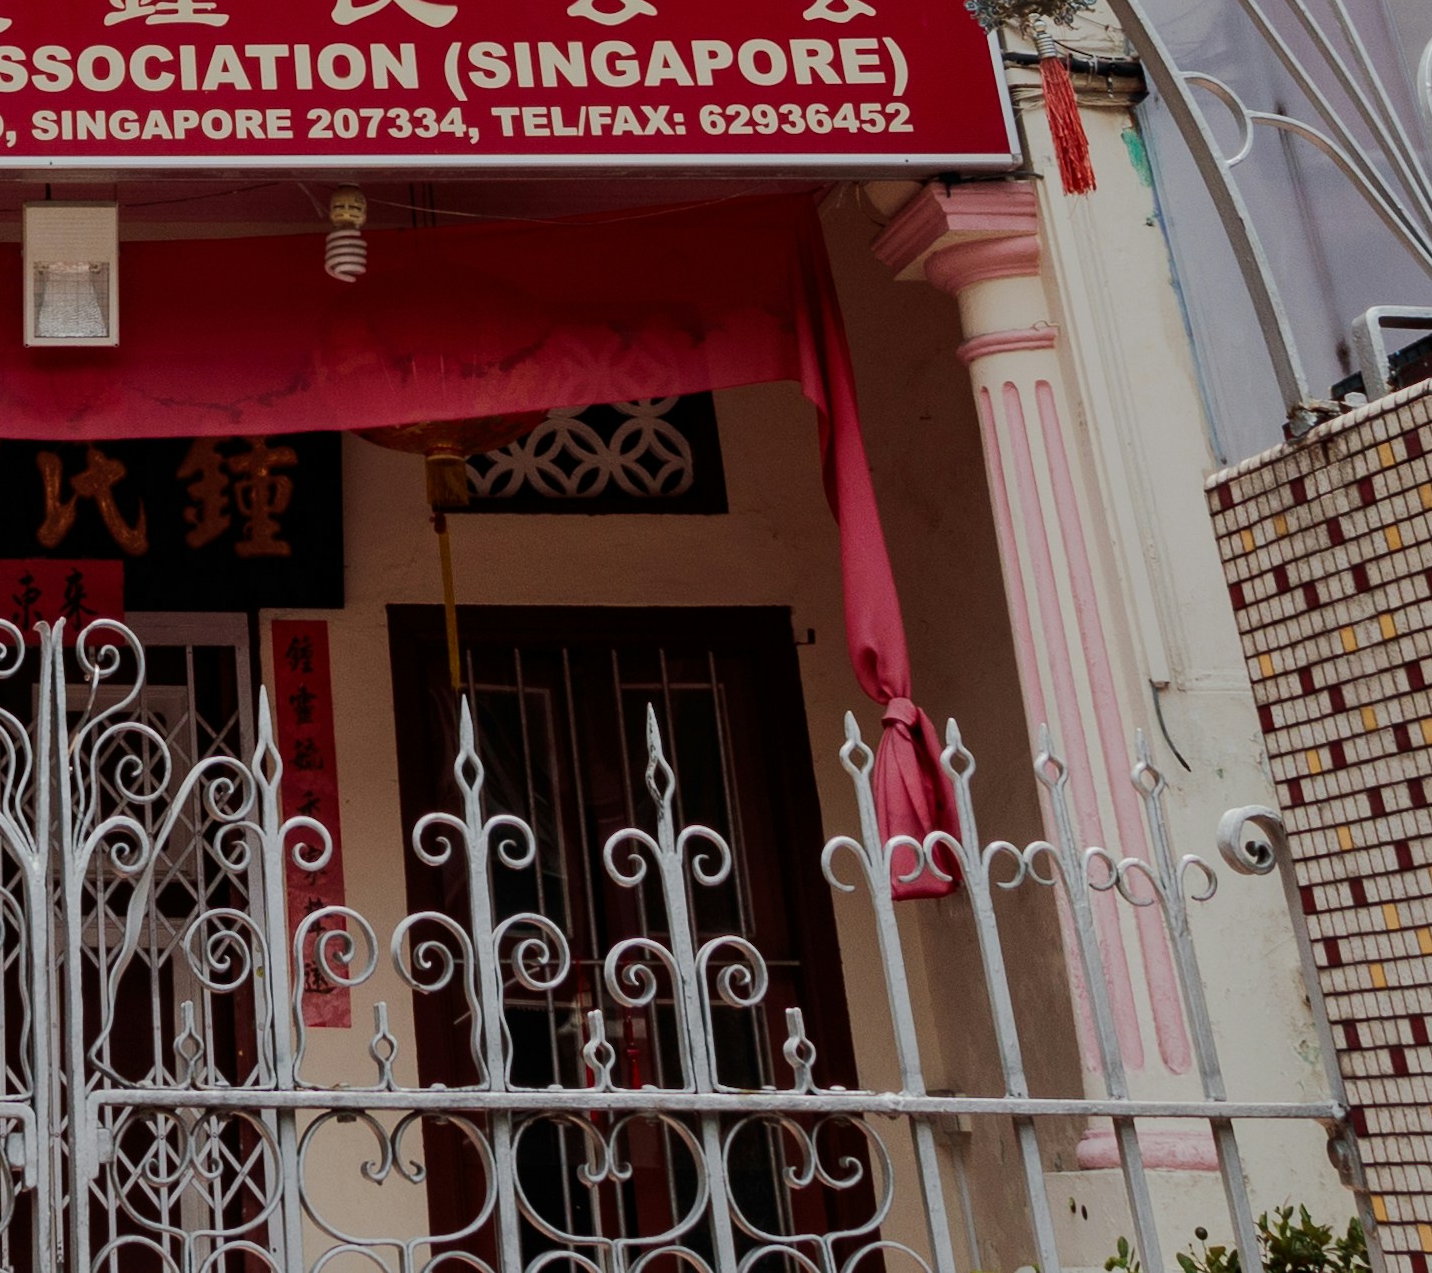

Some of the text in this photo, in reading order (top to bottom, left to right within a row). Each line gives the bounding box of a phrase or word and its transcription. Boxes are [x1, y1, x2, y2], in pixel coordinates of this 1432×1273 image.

[443, 38, 908, 101] (SINGAPORE)
[30, 108, 294, 141] SINGAPORE
[305, 107, 481, 144] 207334,
[491, 105, 687, 137] TEL/FAX:
[699, 102, 914, 135] 62936452
